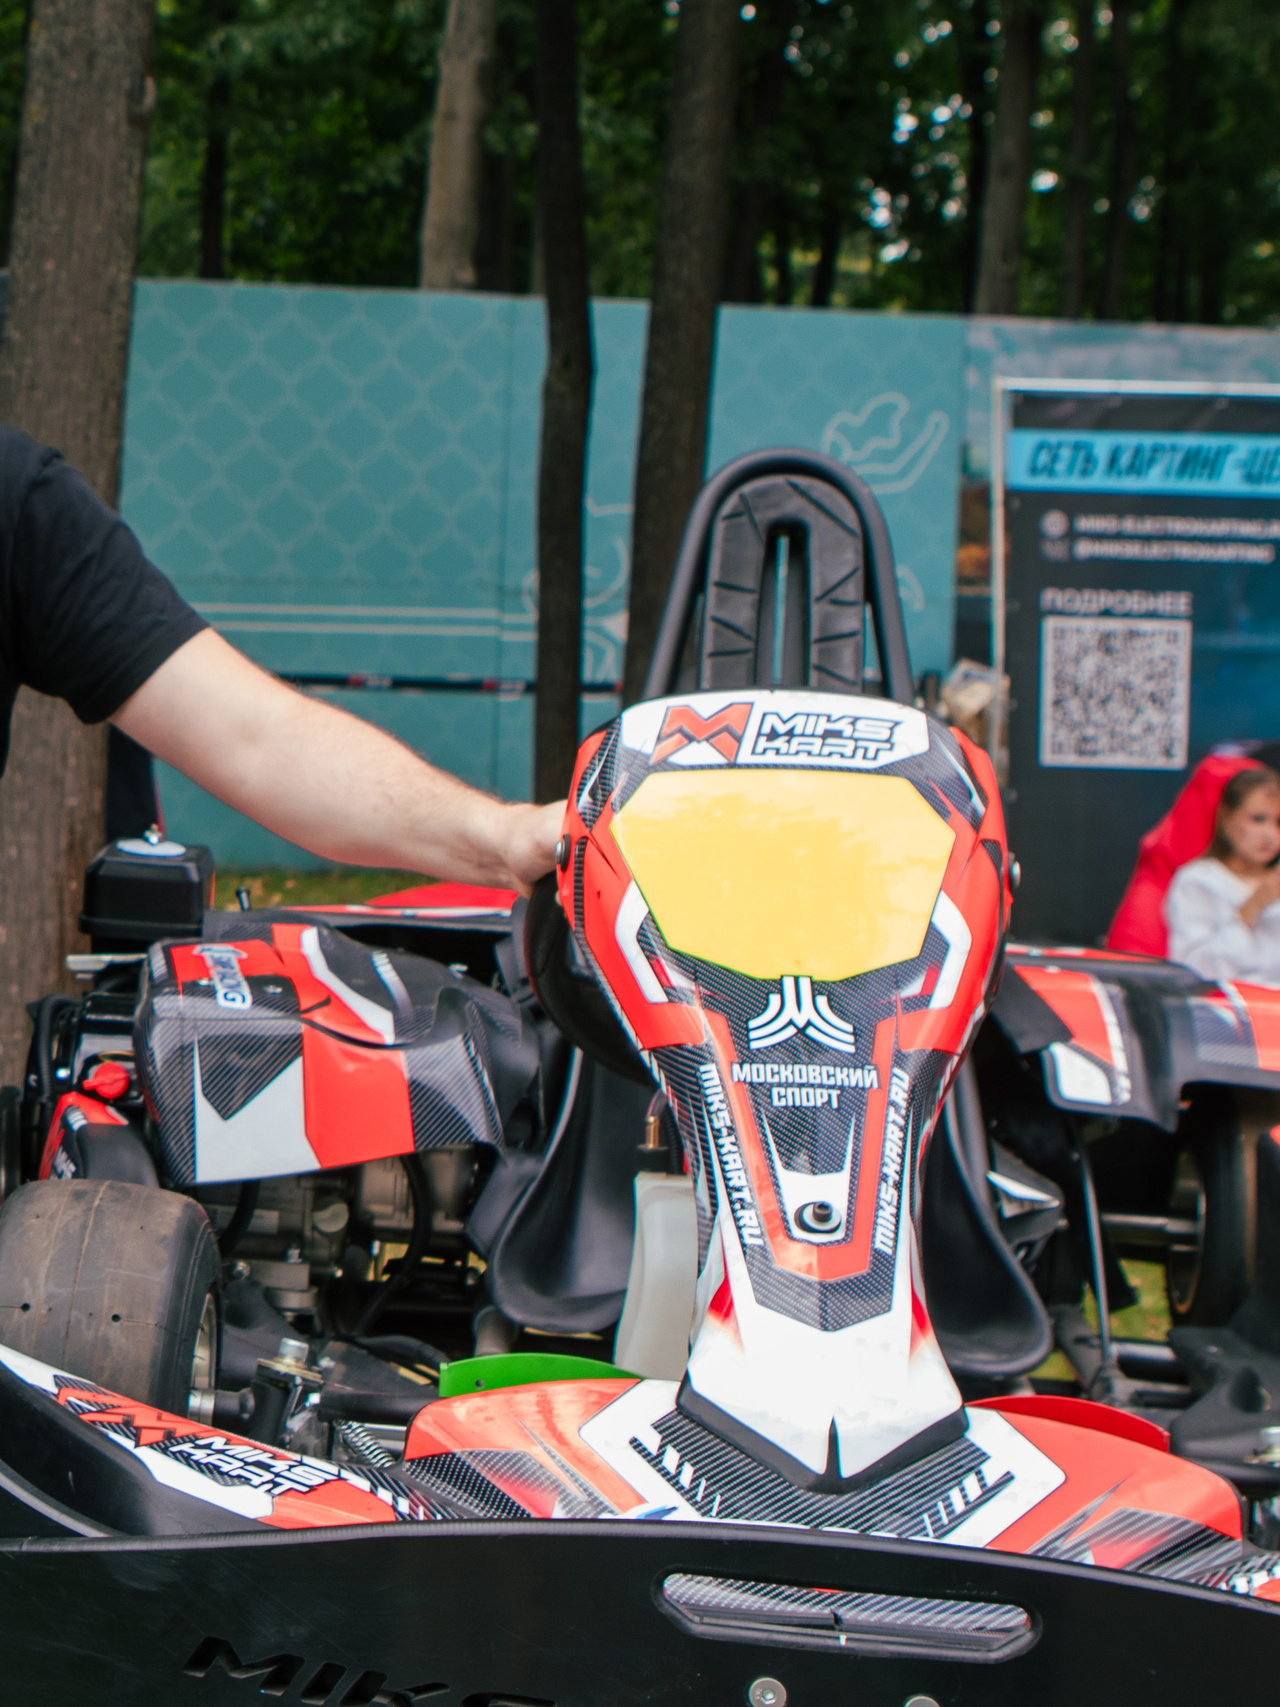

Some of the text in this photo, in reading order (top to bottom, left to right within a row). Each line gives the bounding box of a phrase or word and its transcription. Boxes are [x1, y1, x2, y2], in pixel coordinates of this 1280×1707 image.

[1028, 440, 1098, 477] СЕТЬ
[1040, 587, 1193, 616] ПОДРОБНЕЕ
[760, 712, 900, 738] MIKS
[753, 735, 894, 761] KART
[732, 1063, 879, 1089] МОСКОВСКИЙ
[771, 1086, 841, 1109] СПОРТ
[699, 1063, 764, 1247] MIKS-KART.RU
[874, 1067, 910, 1255] MIKS-KART.RU
[170, 1442, 312, 1496] KART
[194, 1436, 343, 1486] MIKS
